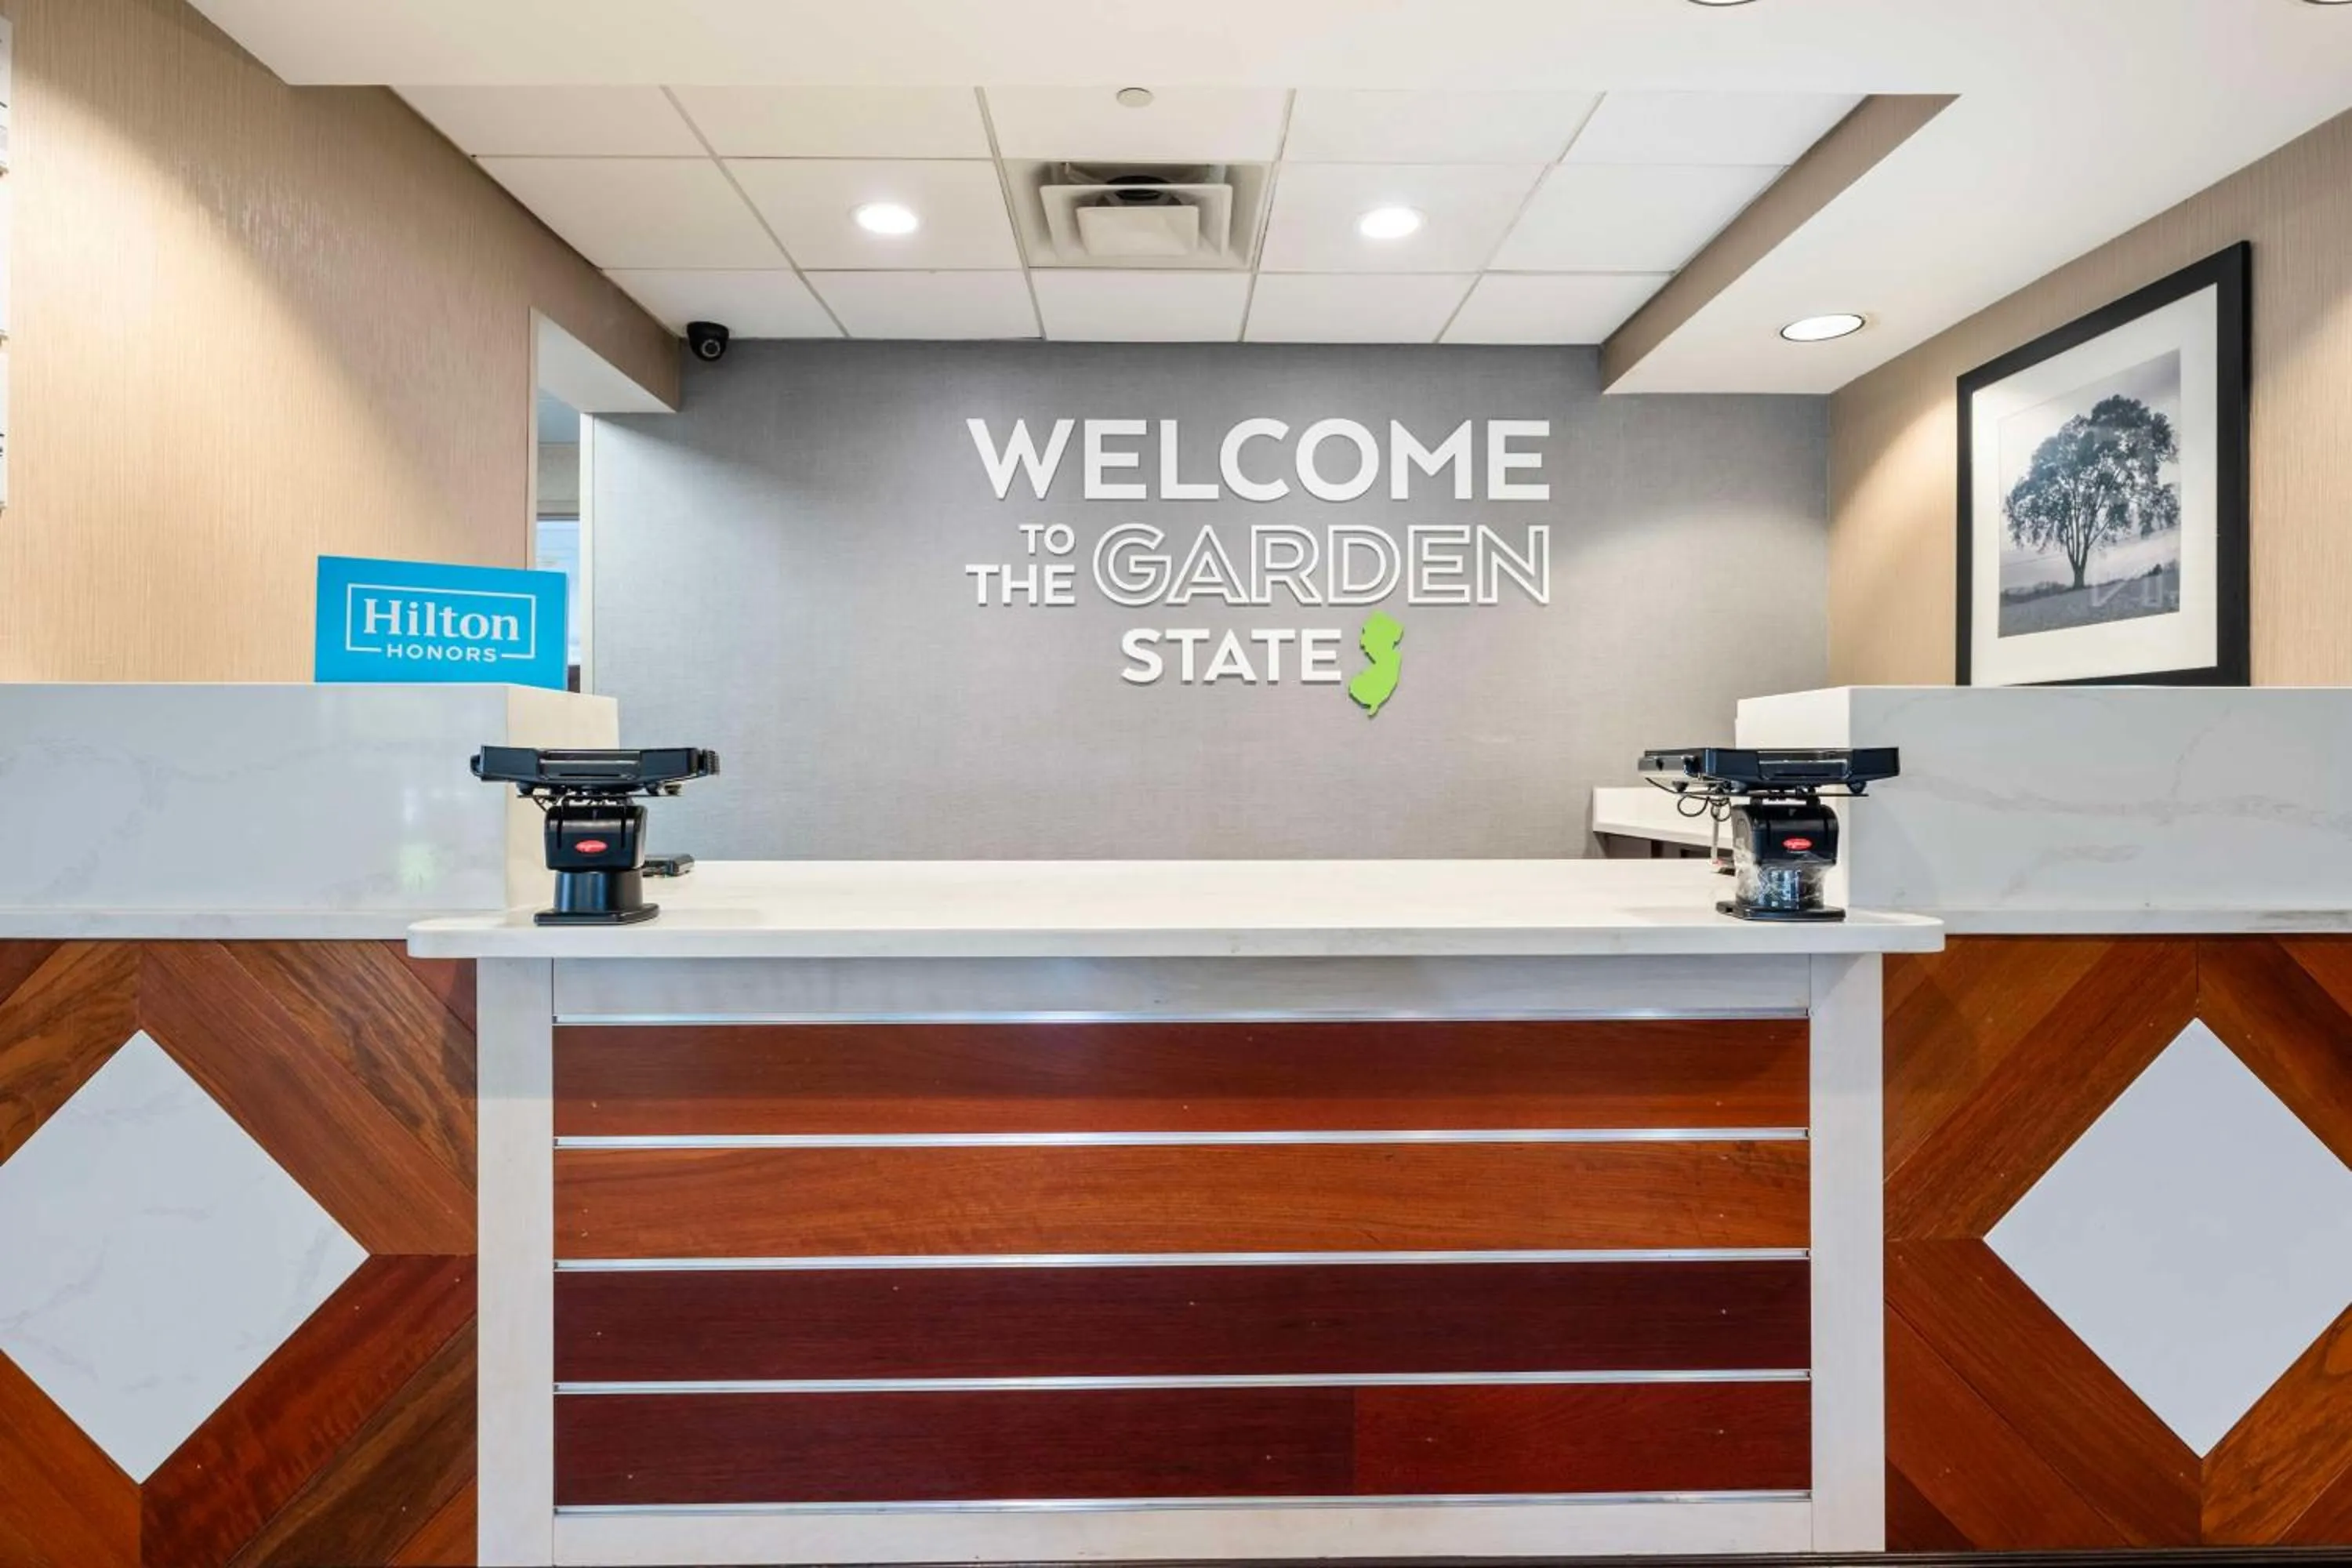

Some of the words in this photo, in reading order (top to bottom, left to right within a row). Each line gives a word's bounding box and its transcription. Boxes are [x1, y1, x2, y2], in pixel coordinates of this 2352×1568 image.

[965, 417, 1551, 501] WELCOME
[1018, 523, 1076, 554] TO
[965, 564, 1076, 605] THE
[1092, 523, 1550, 606] GARDEN
[363, 598, 519, 641] Hilton
[387, 643, 498, 662] HONORS
[1120, 628, 1342, 683] STATE
